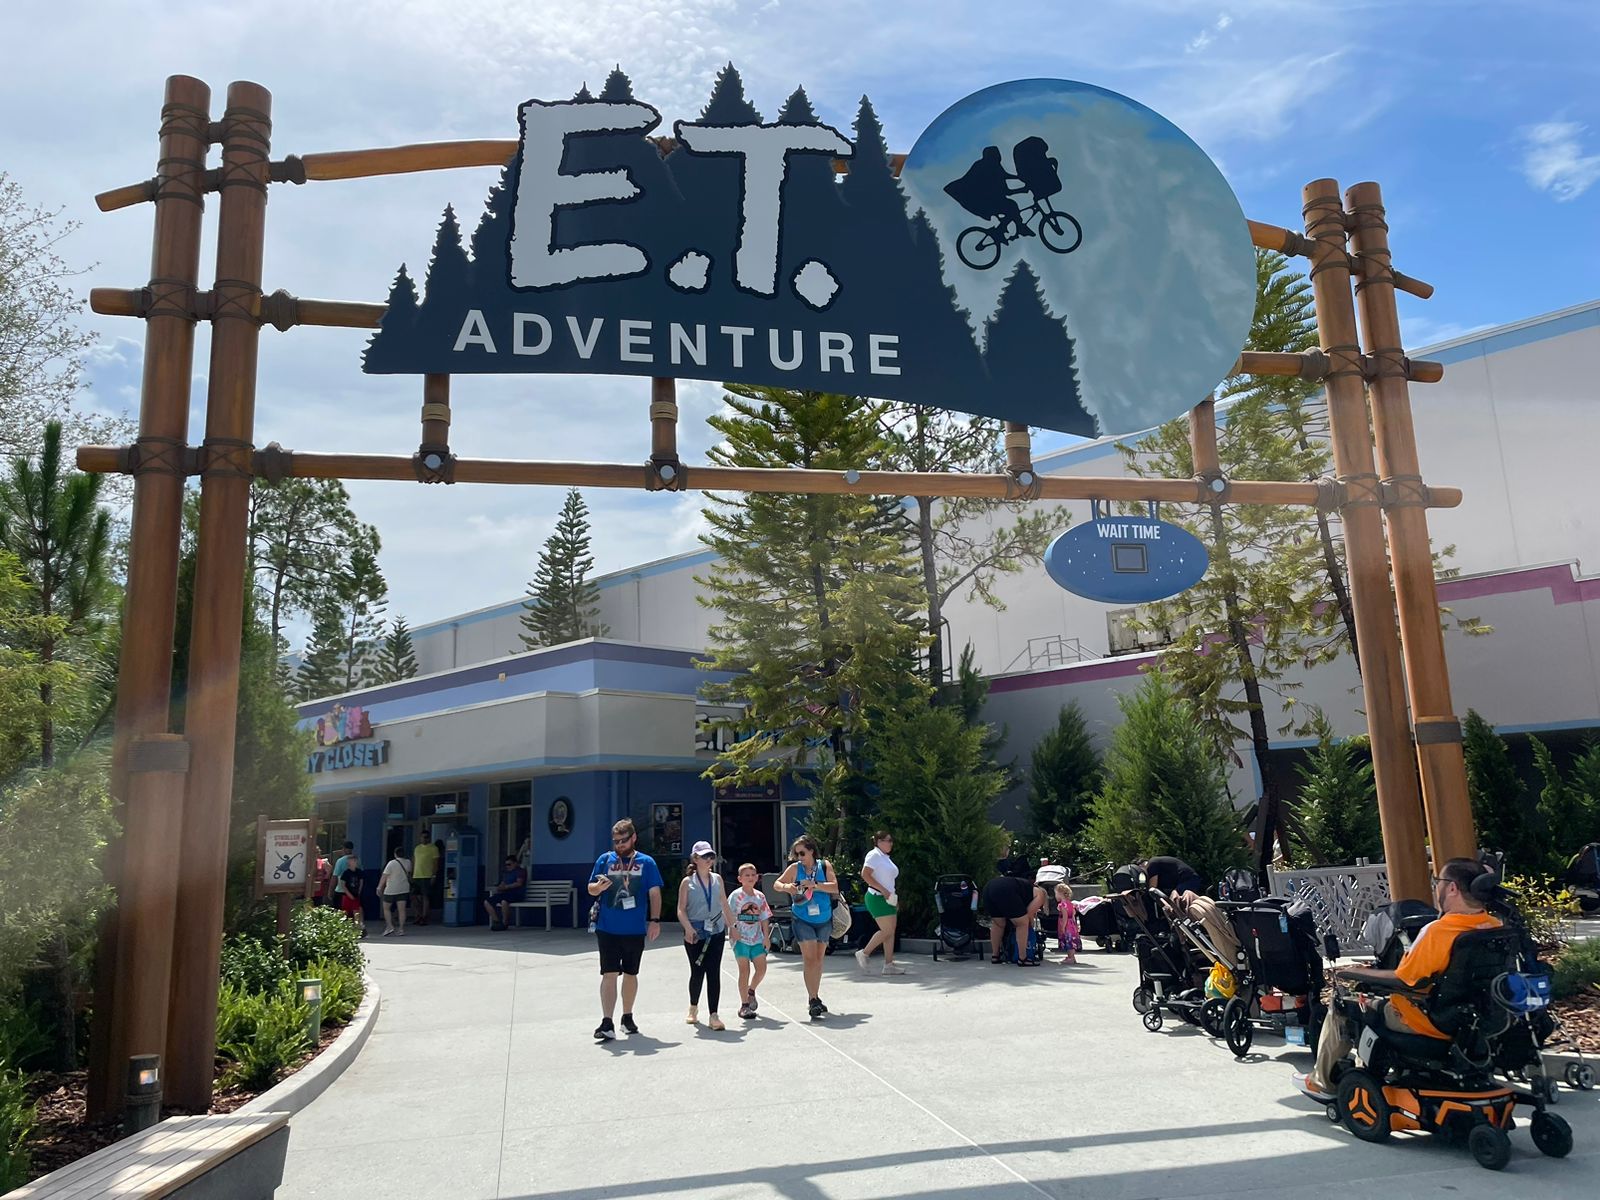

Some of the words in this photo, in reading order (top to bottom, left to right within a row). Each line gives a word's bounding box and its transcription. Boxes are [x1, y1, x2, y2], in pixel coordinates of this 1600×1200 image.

[509, 100, 854, 310] E.T.
[452, 309, 903, 376] ADVENTURE
[1096, 523, 1129, 539] WAIT
[1131, 524, 1161, 540] TIME
[324, 740, 390, 772] CLOSET
